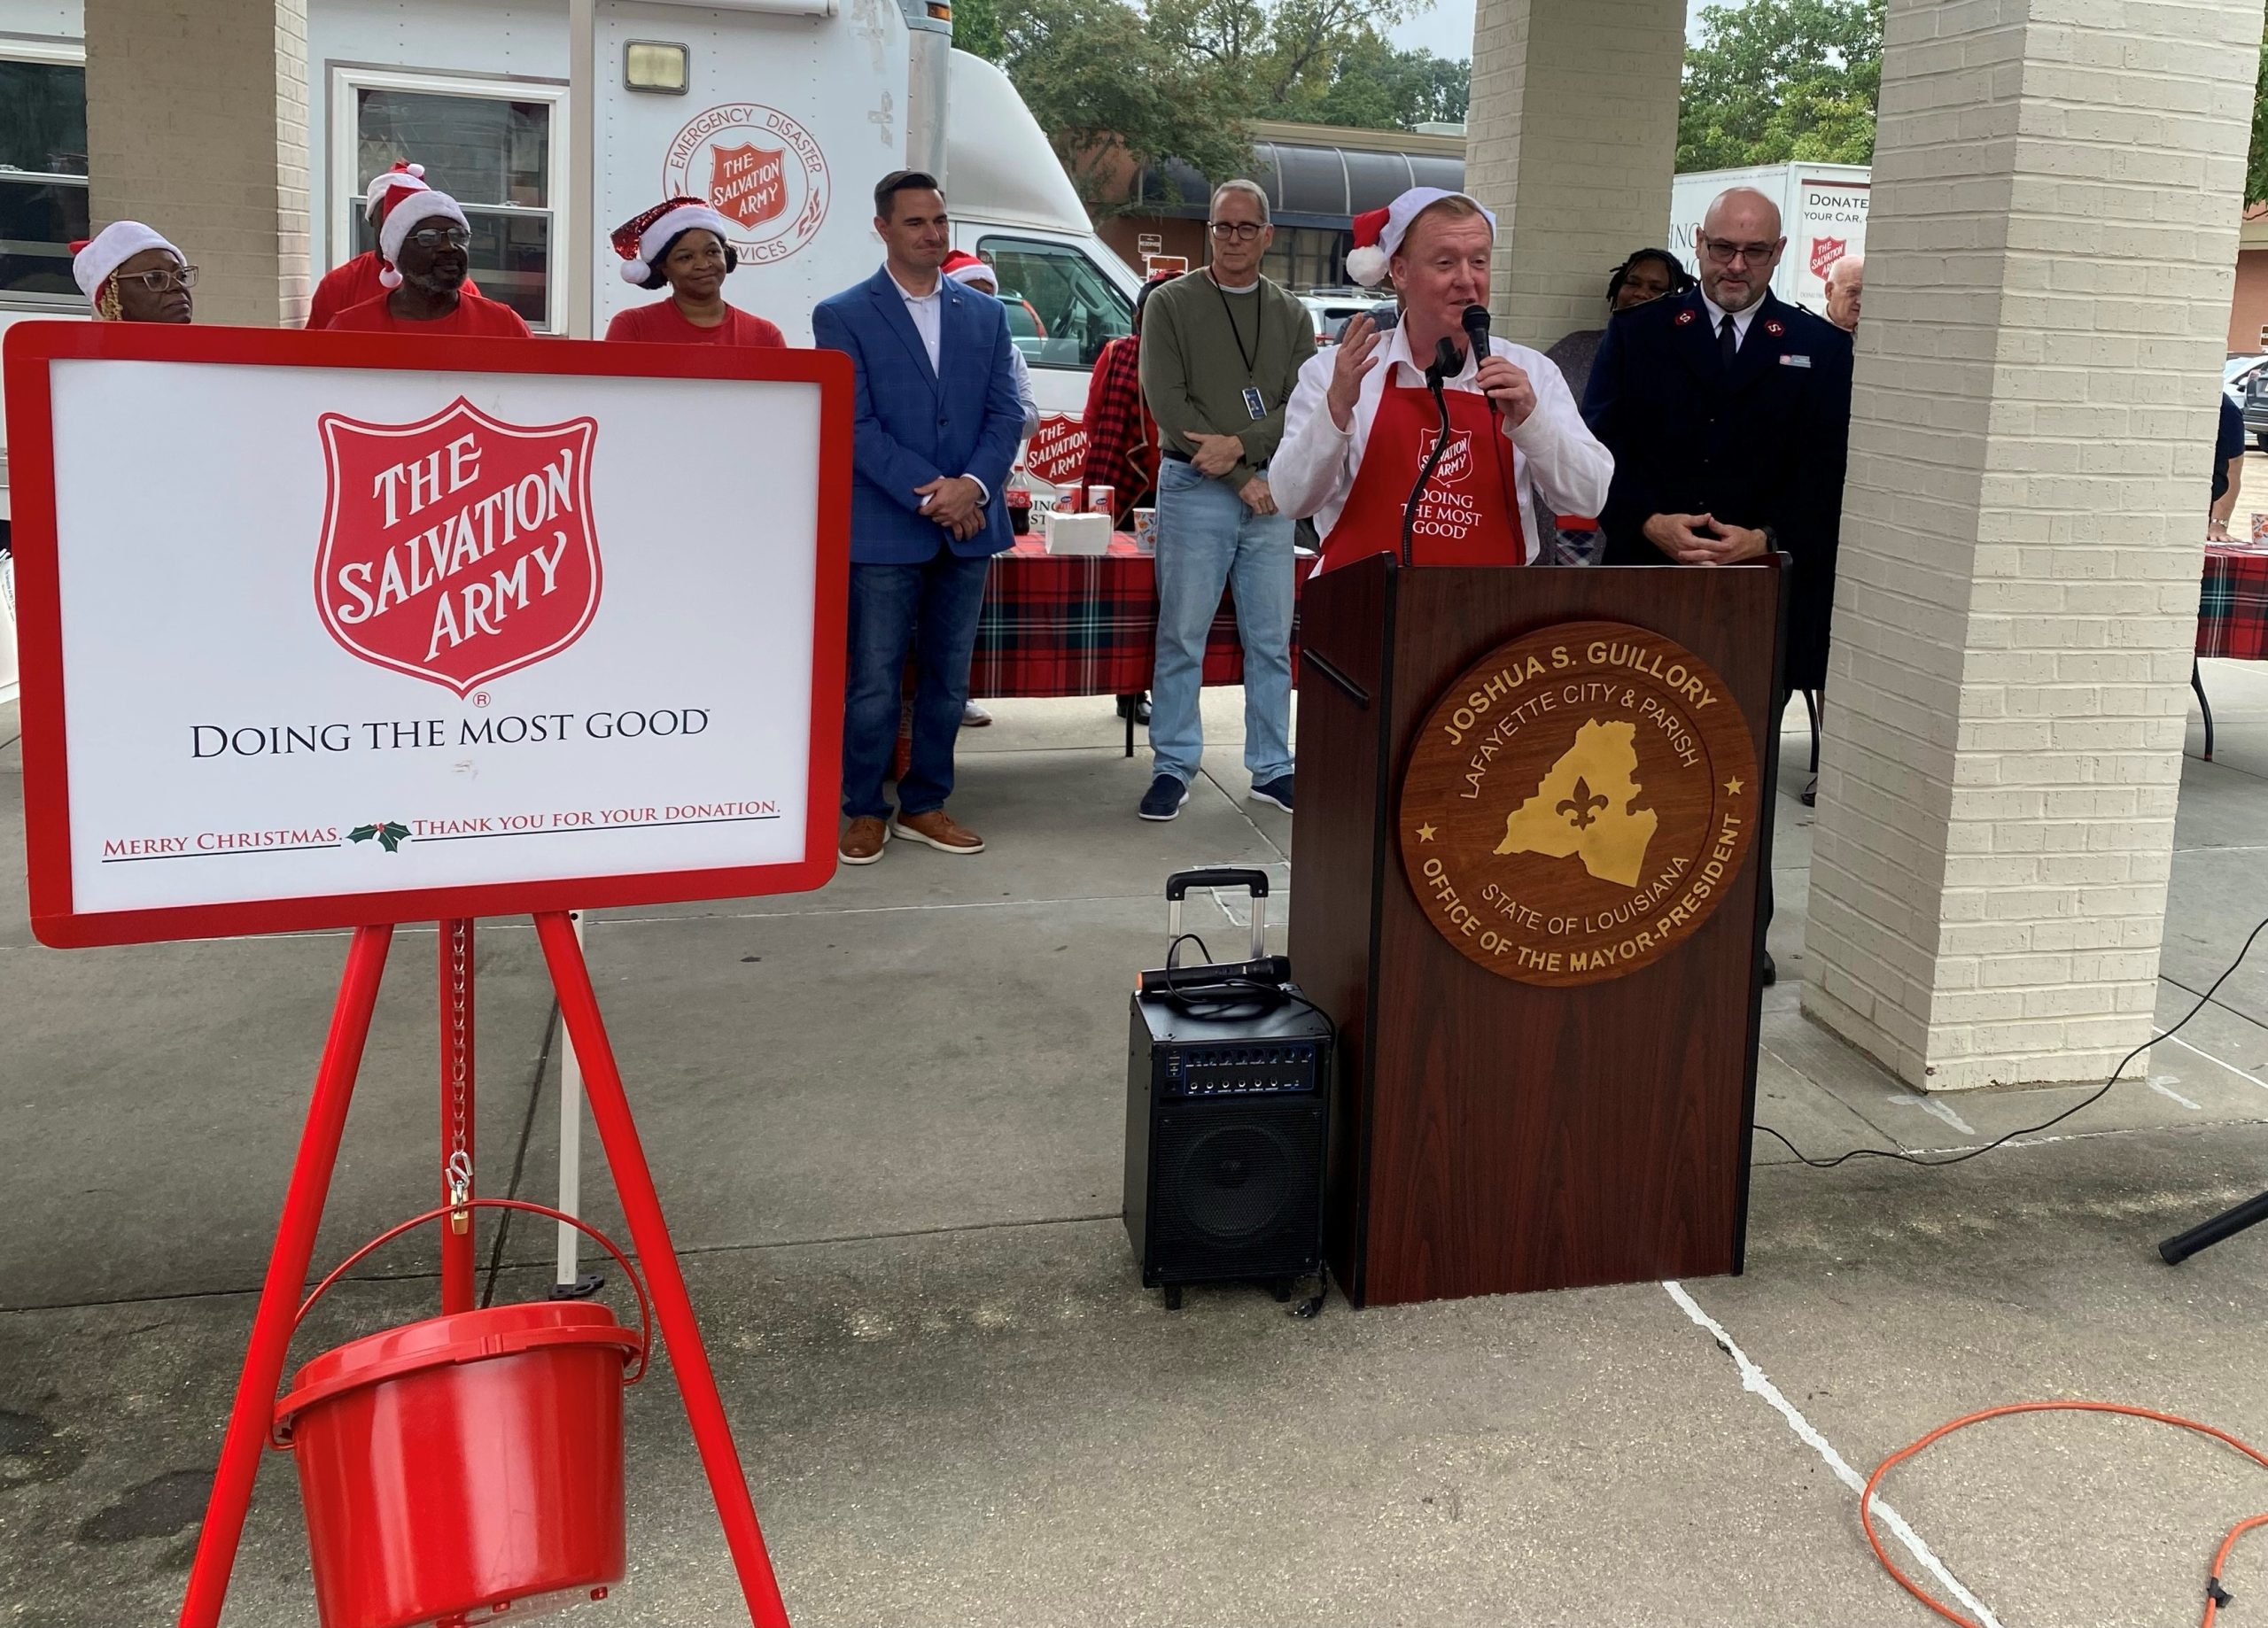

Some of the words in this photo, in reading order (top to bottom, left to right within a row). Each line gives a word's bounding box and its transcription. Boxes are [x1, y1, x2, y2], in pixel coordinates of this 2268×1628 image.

[671, 108, 753, 169] EMERGENCY
[766, 113, 822, 173] DISASTER
[714, 158, 780, 206] SALVATION
[723, 152, 754, 178] THE
[738, 182, 779, 218] ARMY
[1804, 212, 1832, 221] YOUR
[1809, 193, 1869, 209] DONATE
[729, 240, 788, 261] VICES
[1812, 244, 1843, 269] SALVATION
[1818, 241, 1832, 255] THE
[1029, 431, 1088, 469] SALVATION
[1039, 423, 1066, 444] THE
[372, 432, 483, 530] THE
[1049, 448, 1085, 478] ARMY
[1436, 454, 1466, 478] ARMY
[1412, 520, 1466, 539] GOOD
[1436, 507, 1482, 526] MOST
[338, 448, 573, 624] SALVATION
[423, 531, 568, 663] ARMY
[1443, 656, 1546, 747] JOSHUA
[1551, 646, 1577, 669] S.
[1587, 641, 1718, 711] GUILLORY
[190, 724, 352, 758] DOING
[362, 719, 446, 750] THE
[457, 714, 574, 745] MOST
[585, 709, 709, 738] GOOD
[1460, 691, 1555, 800] LAFAYETTE
[1563, 683, 1619, 704] CITY
[1620, 689, 1635, 707] &
[1639, 697, 1699, 768] PARISH
[102, 837, 189, 857] MERRY
[412, 818, 493, 836] THANK
[498, 814, 544, 830] YOU
[552, 811, 595, 827] FOR
[599, 807, 658, 824] YOUR
[664, 800, 781, 820] DONATION.
[1423, 857, 1481, 937] OFFICE
[1480, 931, 1512, 956] OF
[1517, 946, 1560, 972] THE
[1569, 813, 1743, 973] MAYOR-PRESIDENT
[1481, 883, 1543, 933] STATE
[1548, 917, 1578, 935] OF
[1585, 856, 1689, 934] LOUISIANA
